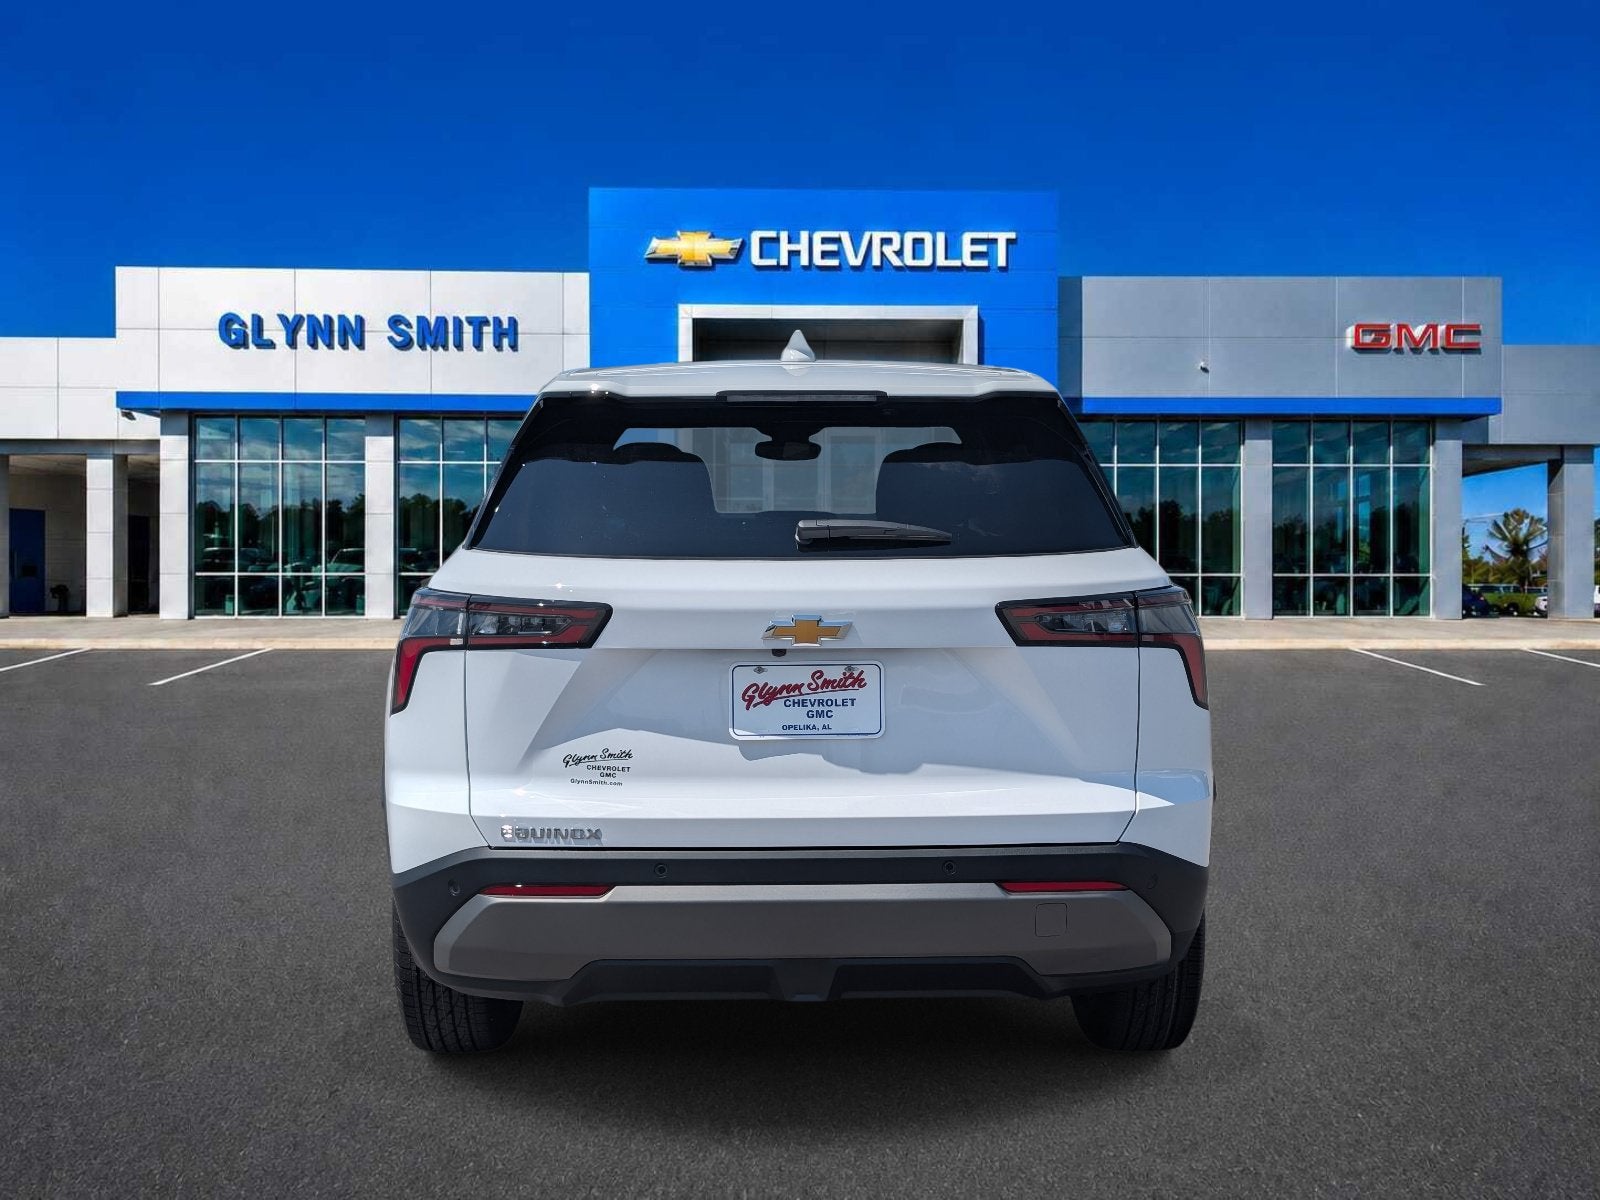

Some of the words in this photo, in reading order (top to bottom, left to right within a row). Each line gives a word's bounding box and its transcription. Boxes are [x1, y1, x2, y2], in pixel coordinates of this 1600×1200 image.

[750, 230, 1017, 269] CHEVROLET
[217, 312, 365, 350] GLYNN
[386, 314, 519, 352] SMITH
[1350, 323, 1482, 350] GMC
[741, 682, 806, 710] Glynn
[807, 669, 867, 692] Smith
[783, 698, 857, 708] CHEVROLET
[806, 709, 834, 719] GMC
[781, 724, 820, 732] OPELIKA,
[821, 723, 833, 731] AL
[562, 753, 598, 768] Glynn
[600, 748, 633, 760] Smith
[586, 764, 631, 773] CHEVROLET
[599, 771, 617, 779] GMC
[570, 778, 623, 787] GlynnSmith.com
[500, 825, 603, 841] EQUINOX
